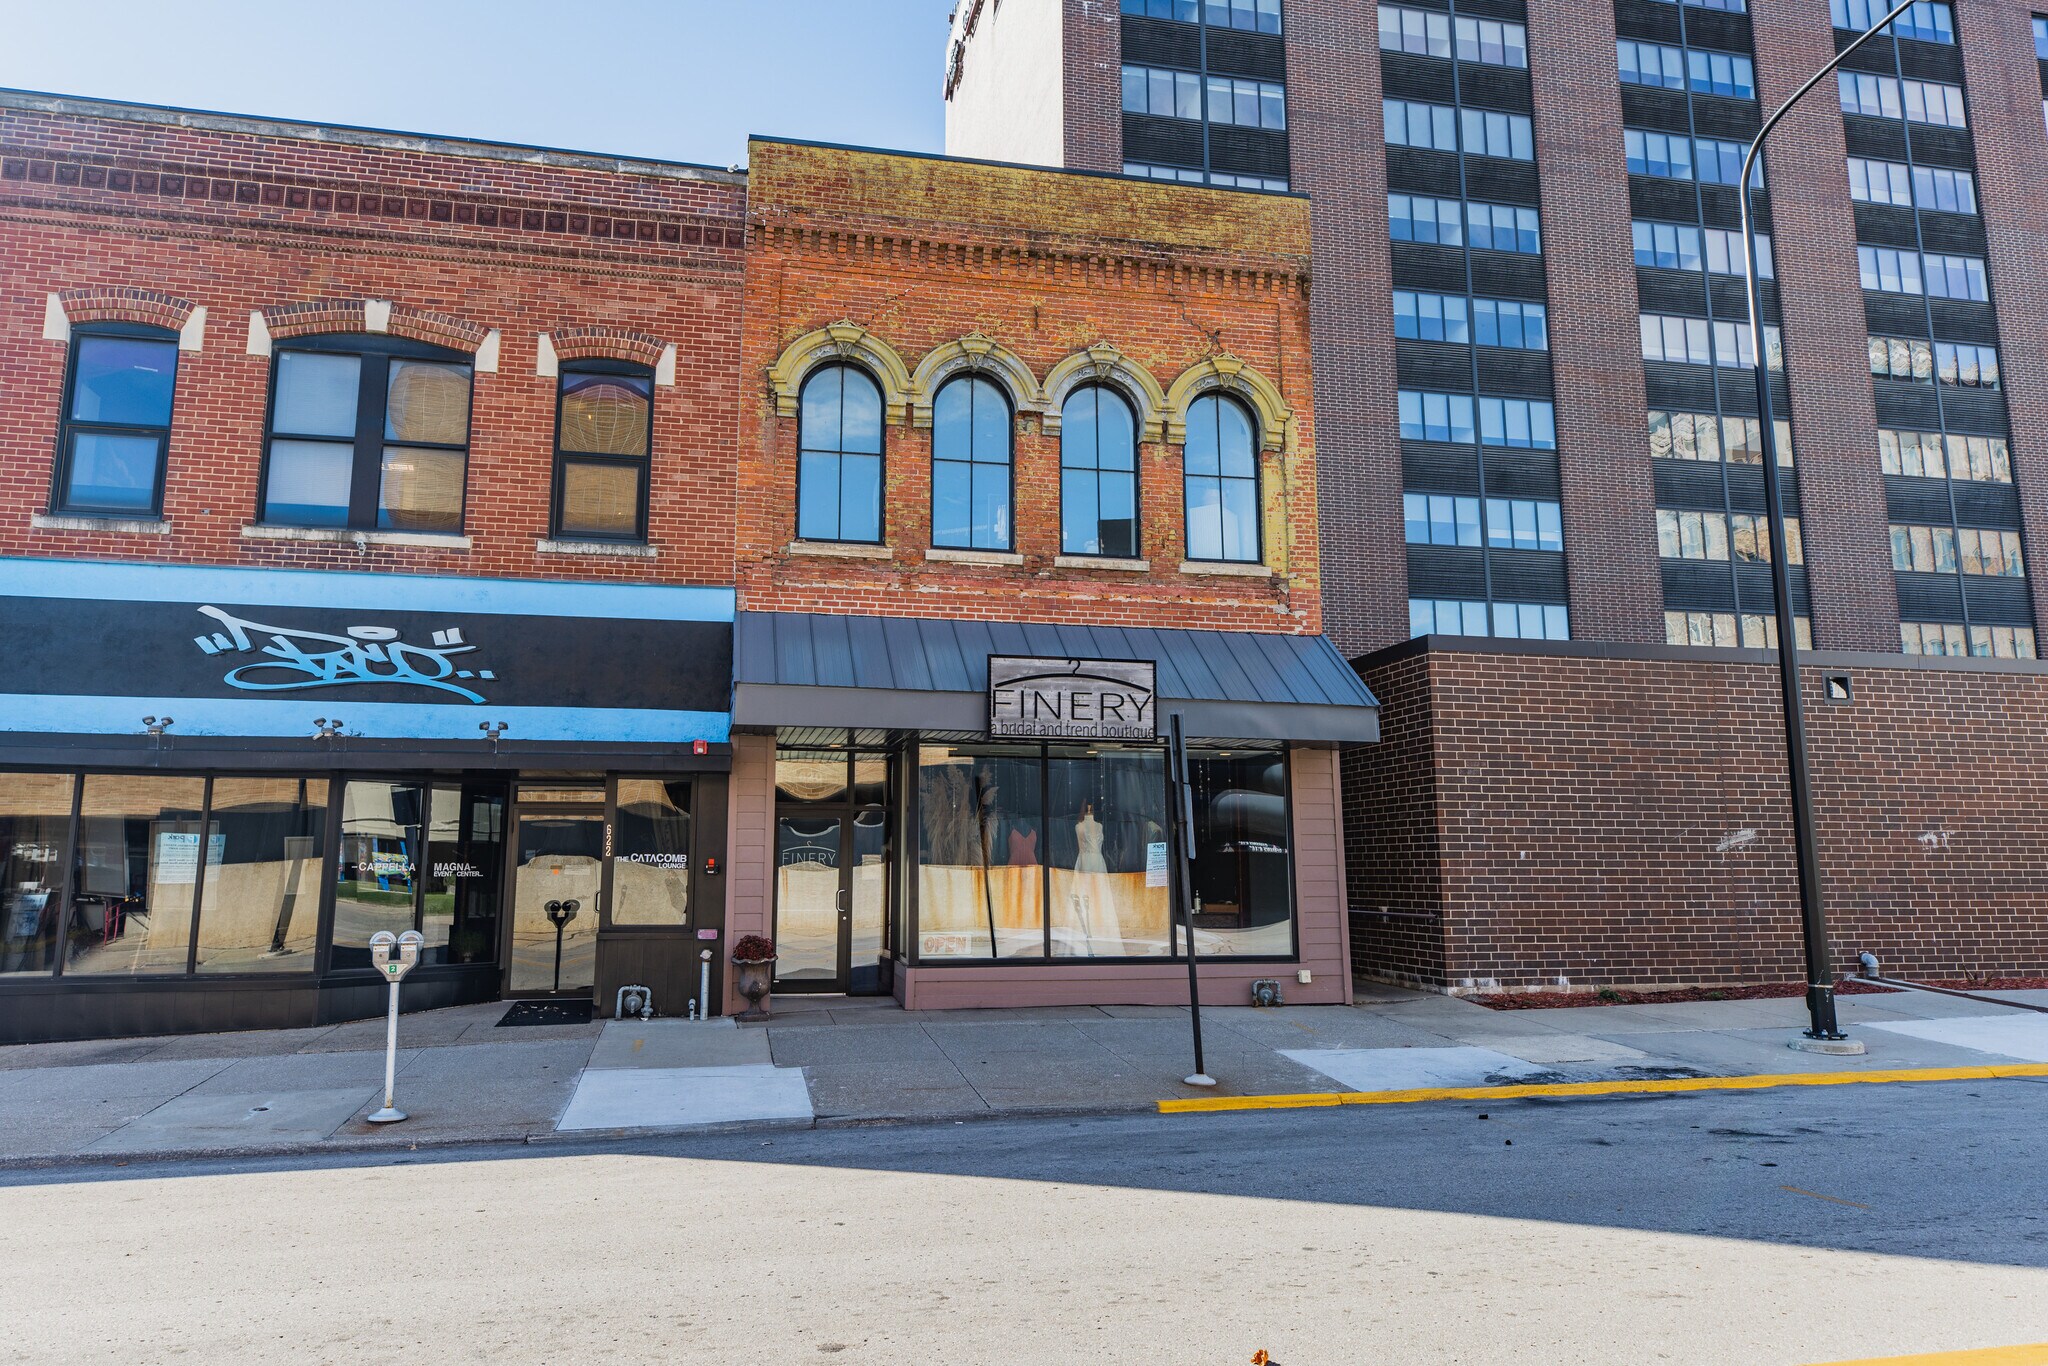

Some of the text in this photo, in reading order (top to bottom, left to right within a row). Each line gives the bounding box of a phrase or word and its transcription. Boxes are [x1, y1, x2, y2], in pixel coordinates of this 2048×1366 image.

[992, 689, 1152, 721] FINERY
[990, 719, 1155, 740] a bridal and trend boutique
[630, 853, 687, 863] CATACOMB
[782, 852, 836, 865] FINERY
[923, 936, 967, 954] OPEN
